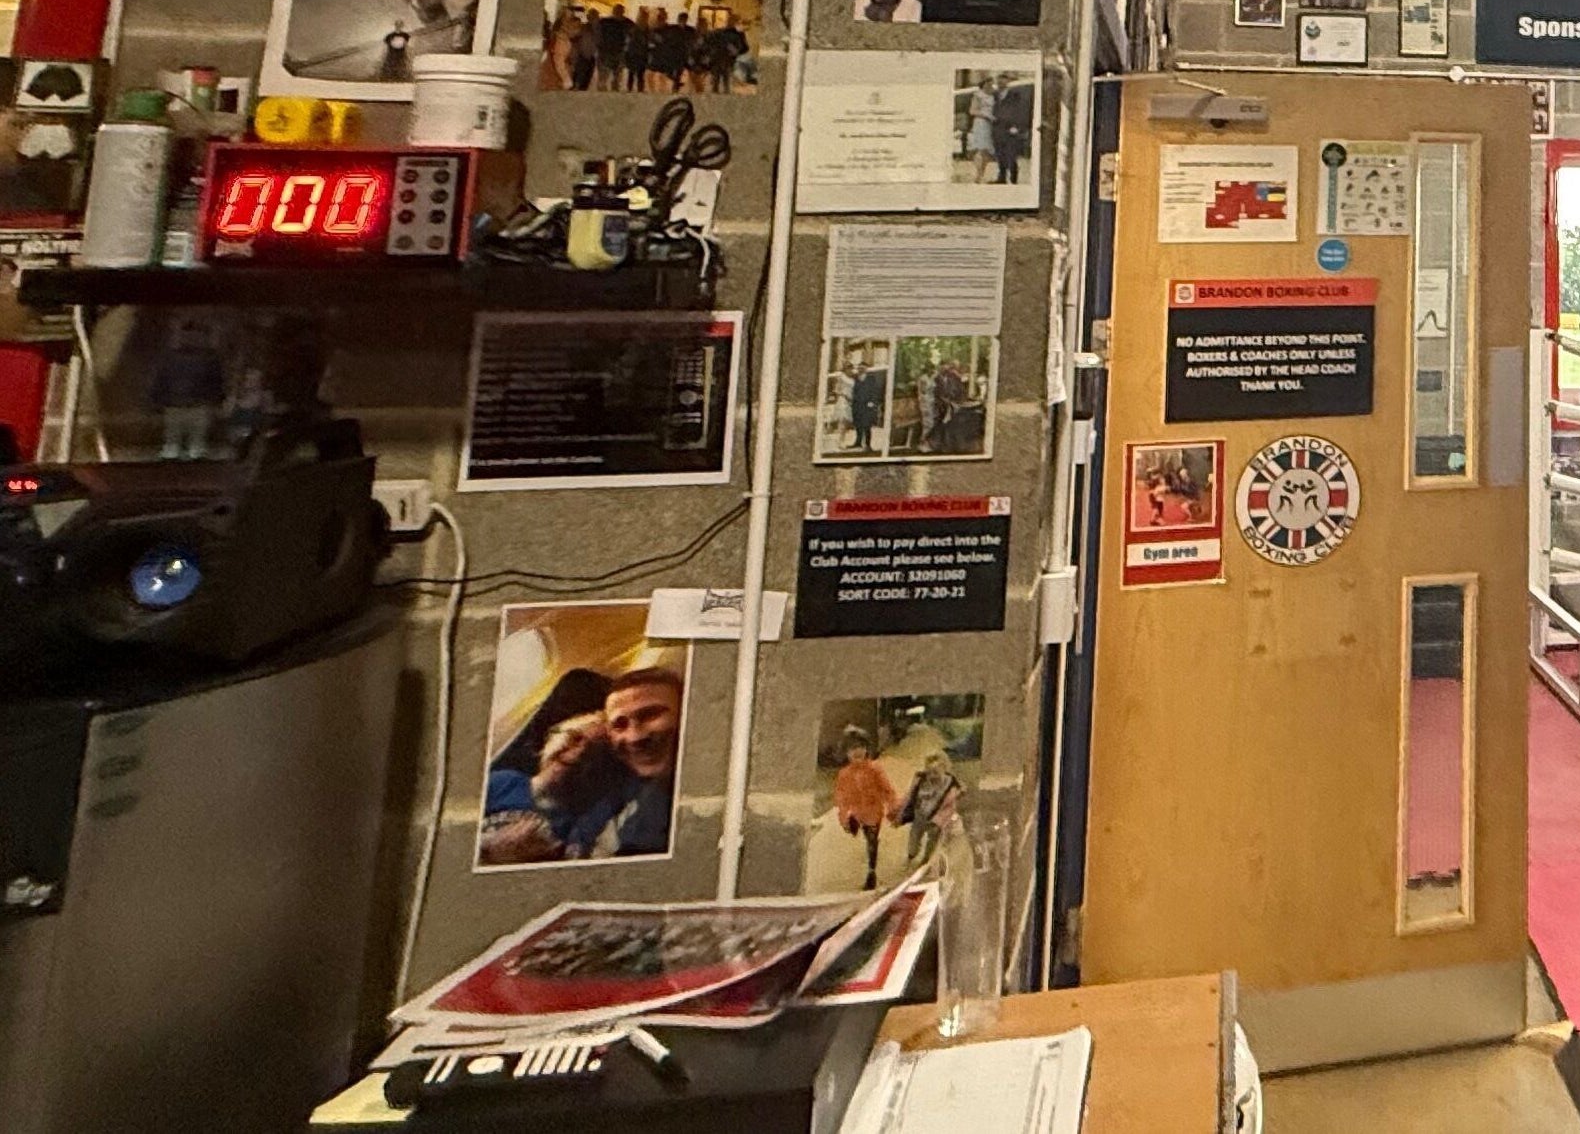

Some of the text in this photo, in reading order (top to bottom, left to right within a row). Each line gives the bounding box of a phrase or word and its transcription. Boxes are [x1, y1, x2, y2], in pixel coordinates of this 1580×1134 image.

[217, 174, 379, 234] 000
[1198, 284, 1349, 299] BRANDON BOXING CLUB
[1176, 337, 1193, 348] NO
[1195, 335, 1263, 347] ADMITTANCE
[1265, 334, 1307, 346] BEYOND
[1309, 334, 1330, 345] THIS
[1187, 349, 1356, 363] BOXERS & COACHES ONLY UNLESS
[1186, 364, 1356, 378] AUTHORISED BY THE HEAD COACH
[1240, 381, 1275, 392] THANK
[1250, 437, 1349, 472] BRANDON
[835, 500, 981, 514] BRANDON BOXING CLUB
[808, 534, 1001, 551] If you wish to pay direct into the
[1243, 516, 1355, 563] BOXING CLUB
[810, 555, 839, 567] Club
[841, 554, 891, 567] Account
[892, 554, 932, 568] please
[934, 555, 954, 564] see
[838, 589, 870, 601] SORT
